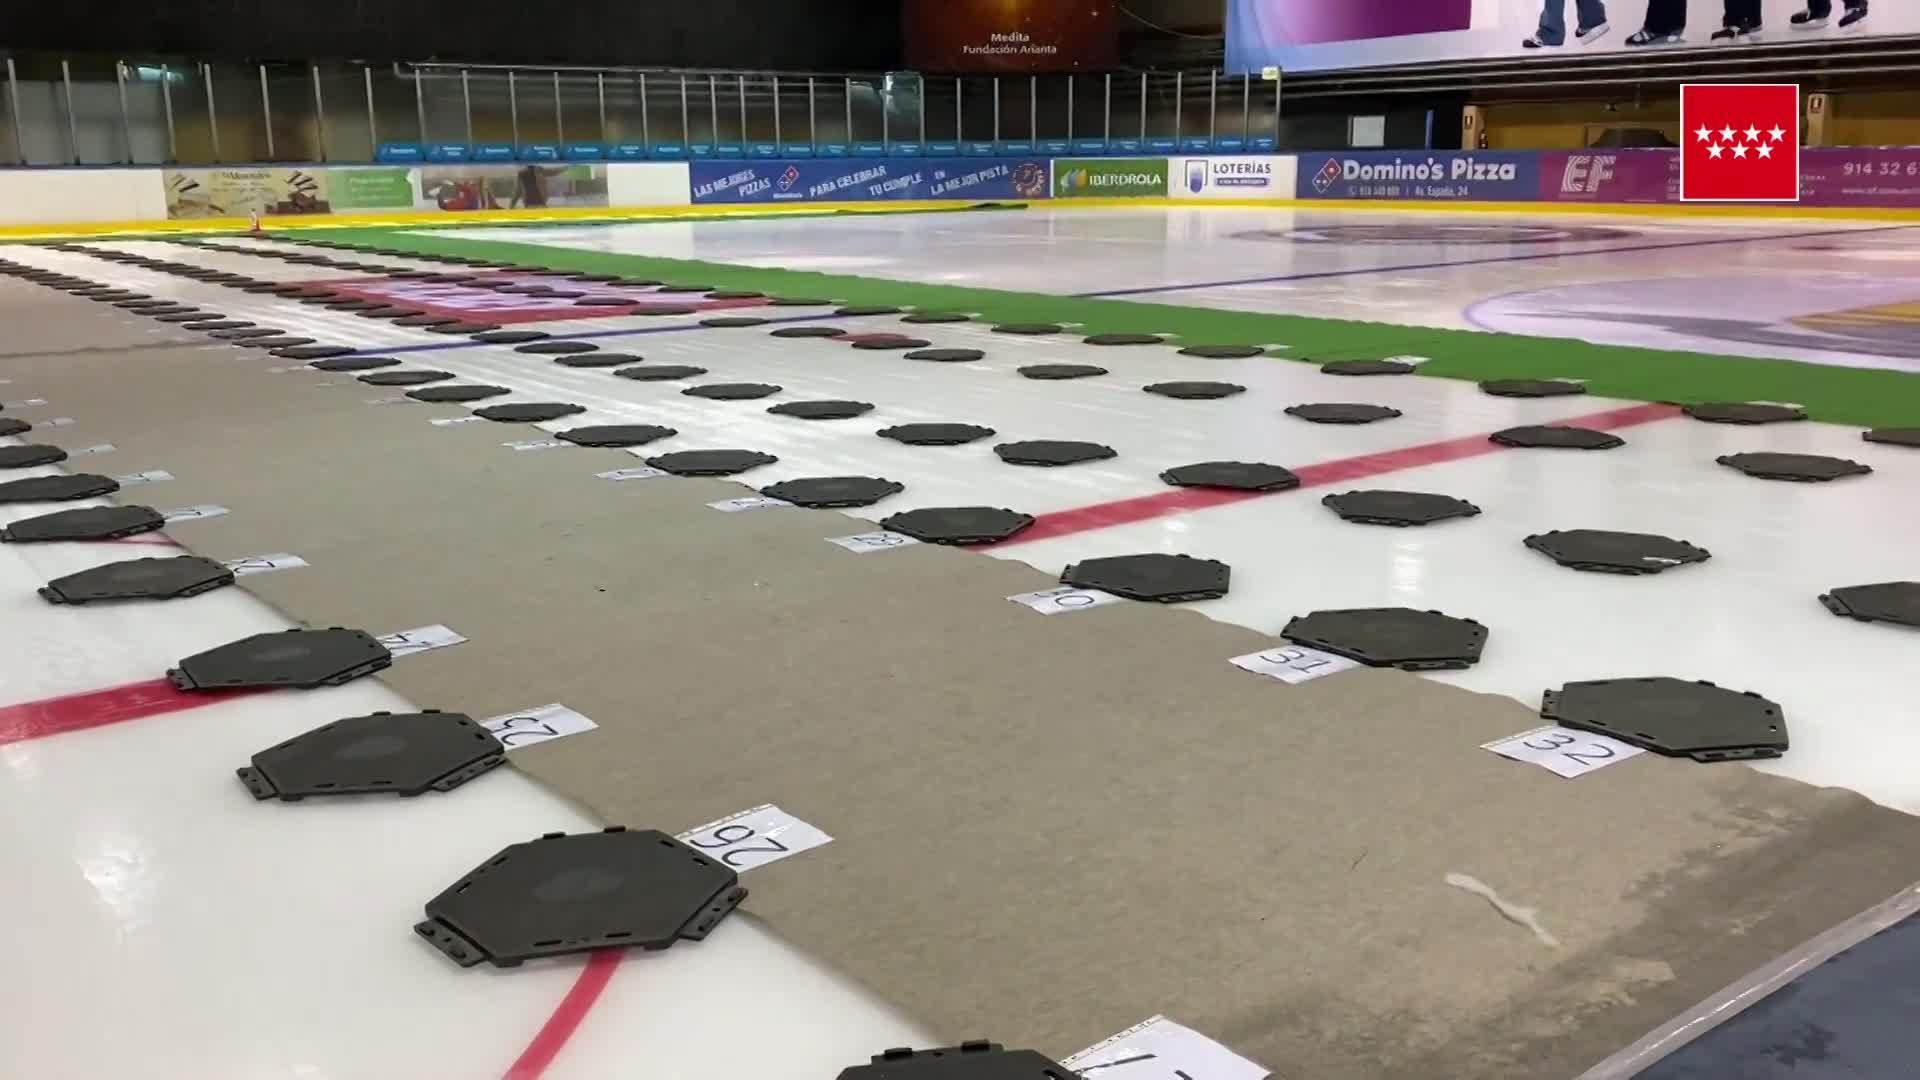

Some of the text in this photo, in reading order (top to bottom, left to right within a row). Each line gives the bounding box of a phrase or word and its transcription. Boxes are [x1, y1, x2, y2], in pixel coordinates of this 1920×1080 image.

[990, 31, 1030, 42] Medita
[963, 44, 1018, 55] Fundación
[930, 183, 945, 196] LA
[944, 173, 979, 192] MEJOR
[979, 164, 1009, 182] PISTA
[1088, 173, 1162, 186] IBERDROLA
[1213, 161, 1272, 174] LOTERÍAS
[1343, 157, 1517, 180] Domino's Pizza
[1560, 155, 1616, 192] EF
[1843, 161, 1920, 176] 914 32 6
[693, 169, 756, 198] LAS MEJORES
[809, 164, 887, 198] PARA CELEBRAR
[868, 172, 923, 197] TU CUMPLE
[1259, 649, 1332, 674] 31
[1522, 733, 1616, 766] 32
[689, 824, 789, 867] 26
